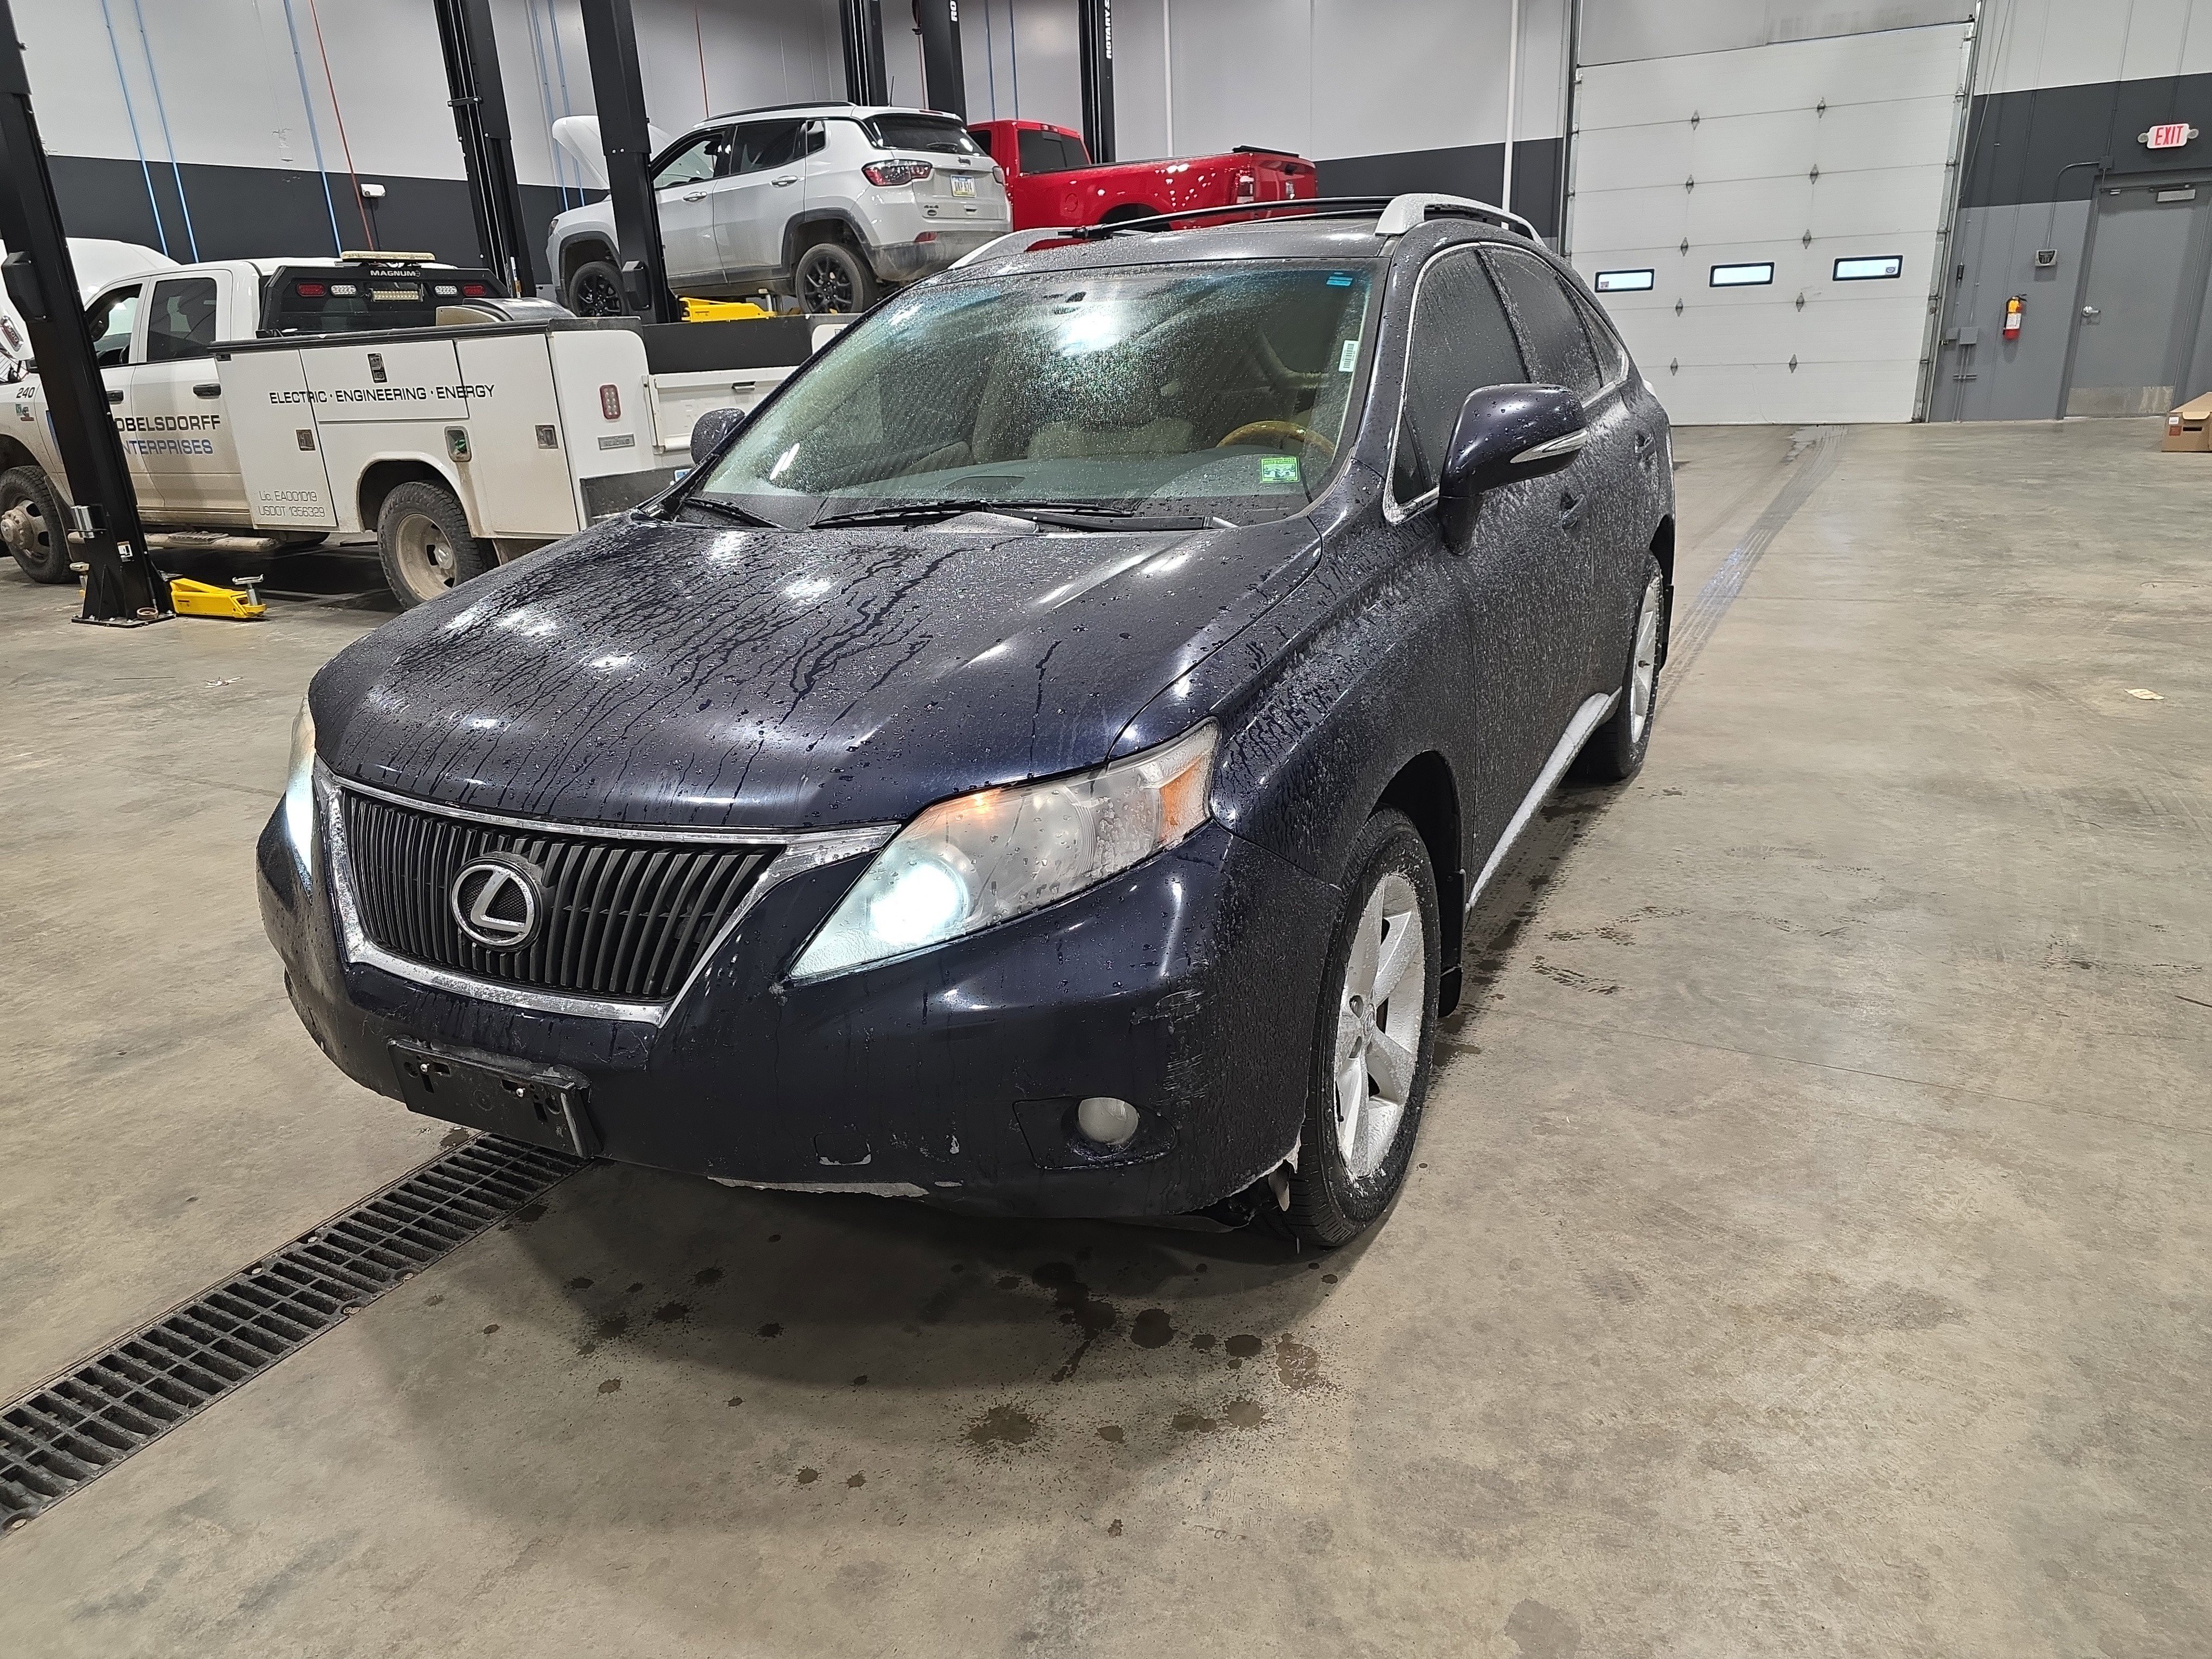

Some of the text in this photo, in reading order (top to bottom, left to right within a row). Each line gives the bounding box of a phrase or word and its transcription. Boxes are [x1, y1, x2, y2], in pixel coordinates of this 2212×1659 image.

[2155, 125, 2184, 146] EXIT
[16, 387, 35, 398] 240
[269, 384, 495, 404] ELECTRIC ENGINEERING ENERGY
[114, 415, 221, 432] OBELSDORFF
[123, 439, 214, 455] NTERPRISES
[259, 490, 318, 501] Lic. EA001019
[258, 505, 325, 517] USDOT 1356329
